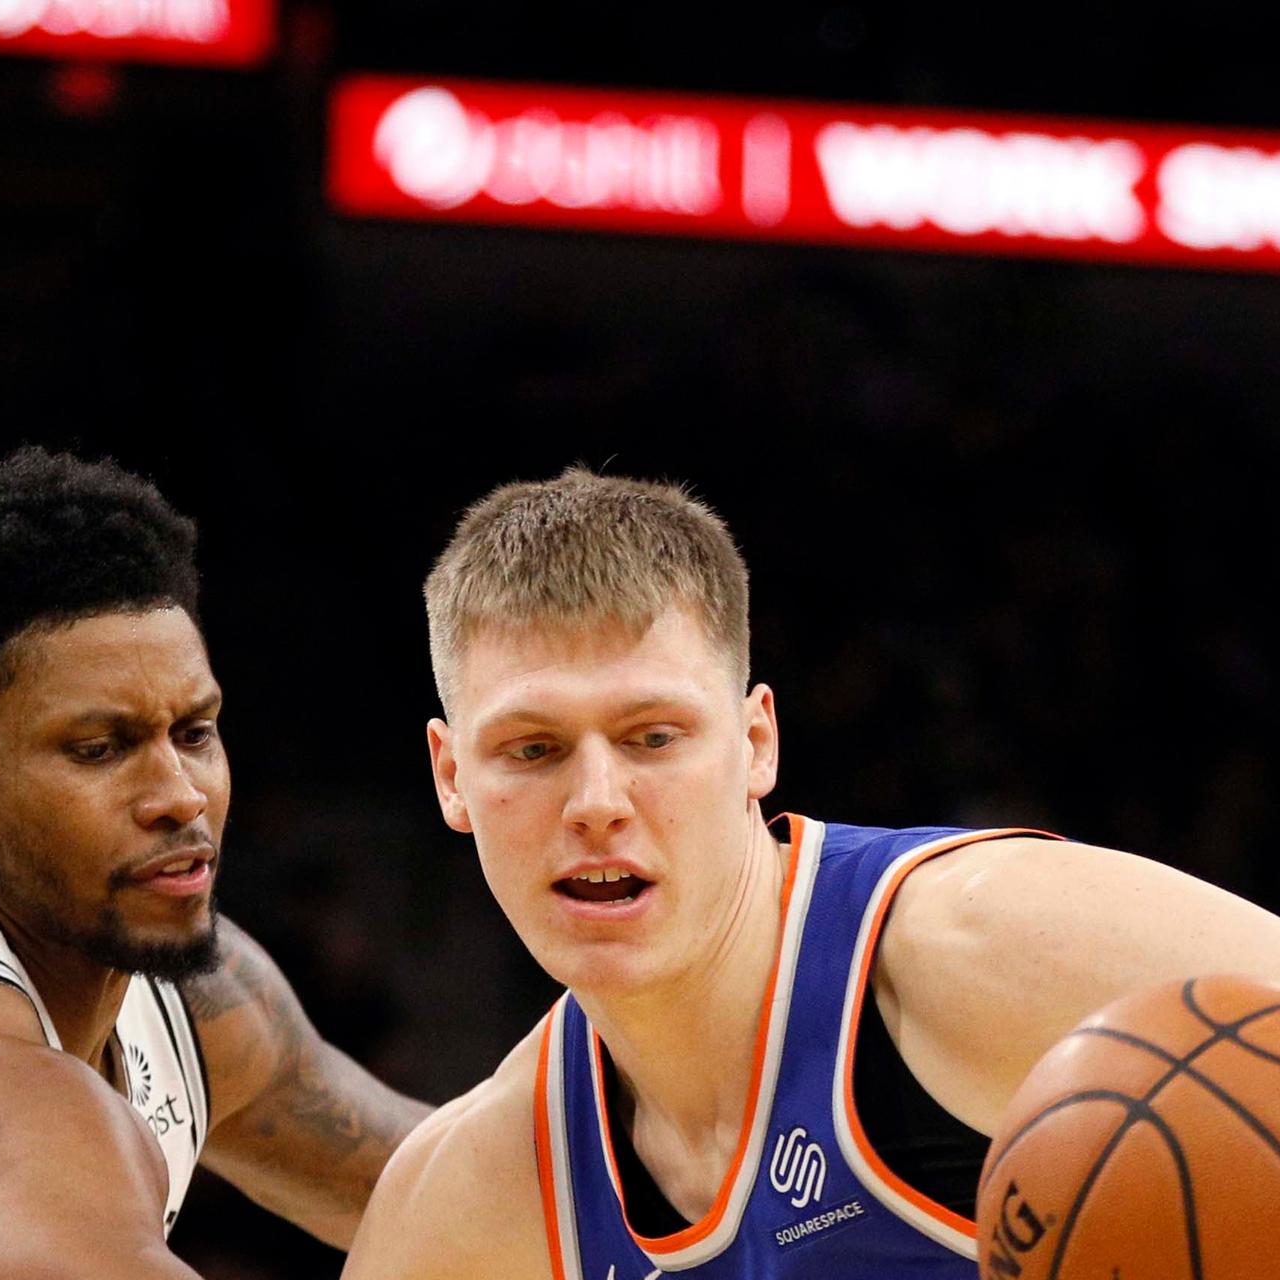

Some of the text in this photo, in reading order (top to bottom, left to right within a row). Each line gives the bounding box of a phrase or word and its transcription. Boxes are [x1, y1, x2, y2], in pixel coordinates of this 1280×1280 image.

[815, 120, 1147, 244] WORK
[147, 1094, 184, 1136] ost
[775, 1201, 865, 1246] SQUARESPACE
